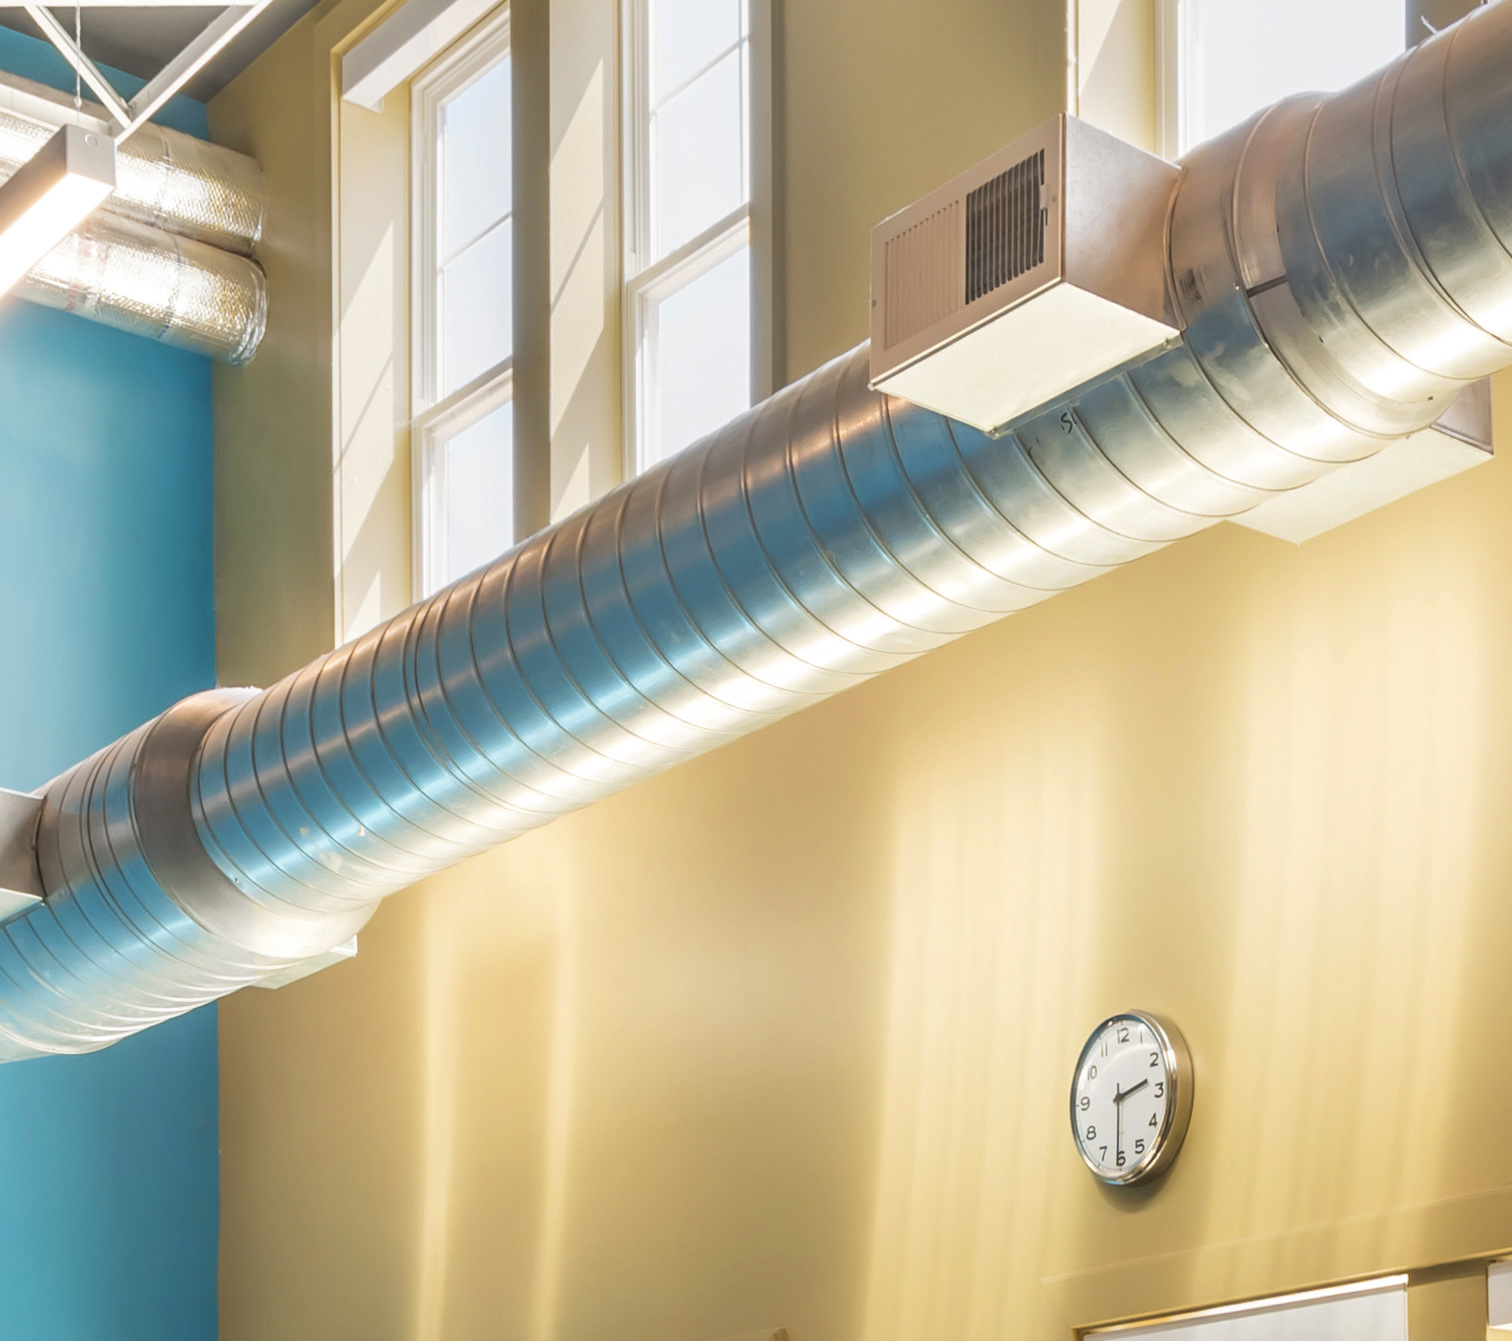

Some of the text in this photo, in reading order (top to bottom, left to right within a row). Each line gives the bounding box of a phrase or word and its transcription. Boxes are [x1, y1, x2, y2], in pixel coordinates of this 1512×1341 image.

[1116, 1027, 1130, 1044] 12
[1100, 1041, 1108, 1057] 11
[1149, 1052, 1159, 1067] 2
[1087, 1065, 1098, 1081] 10
[1153, 1082, 1164, 1098] 3
[1080, 1096, 1091, 1111] 9
[1148, 1112, 1158, 1128] 4
[1085, 1125, 1097, 1140] 8
[1099, 1146, 1108, 1161] 7
[1134, 1139, 1145, 1154] 5
[1117, 1150, 1126, 1166] 6
